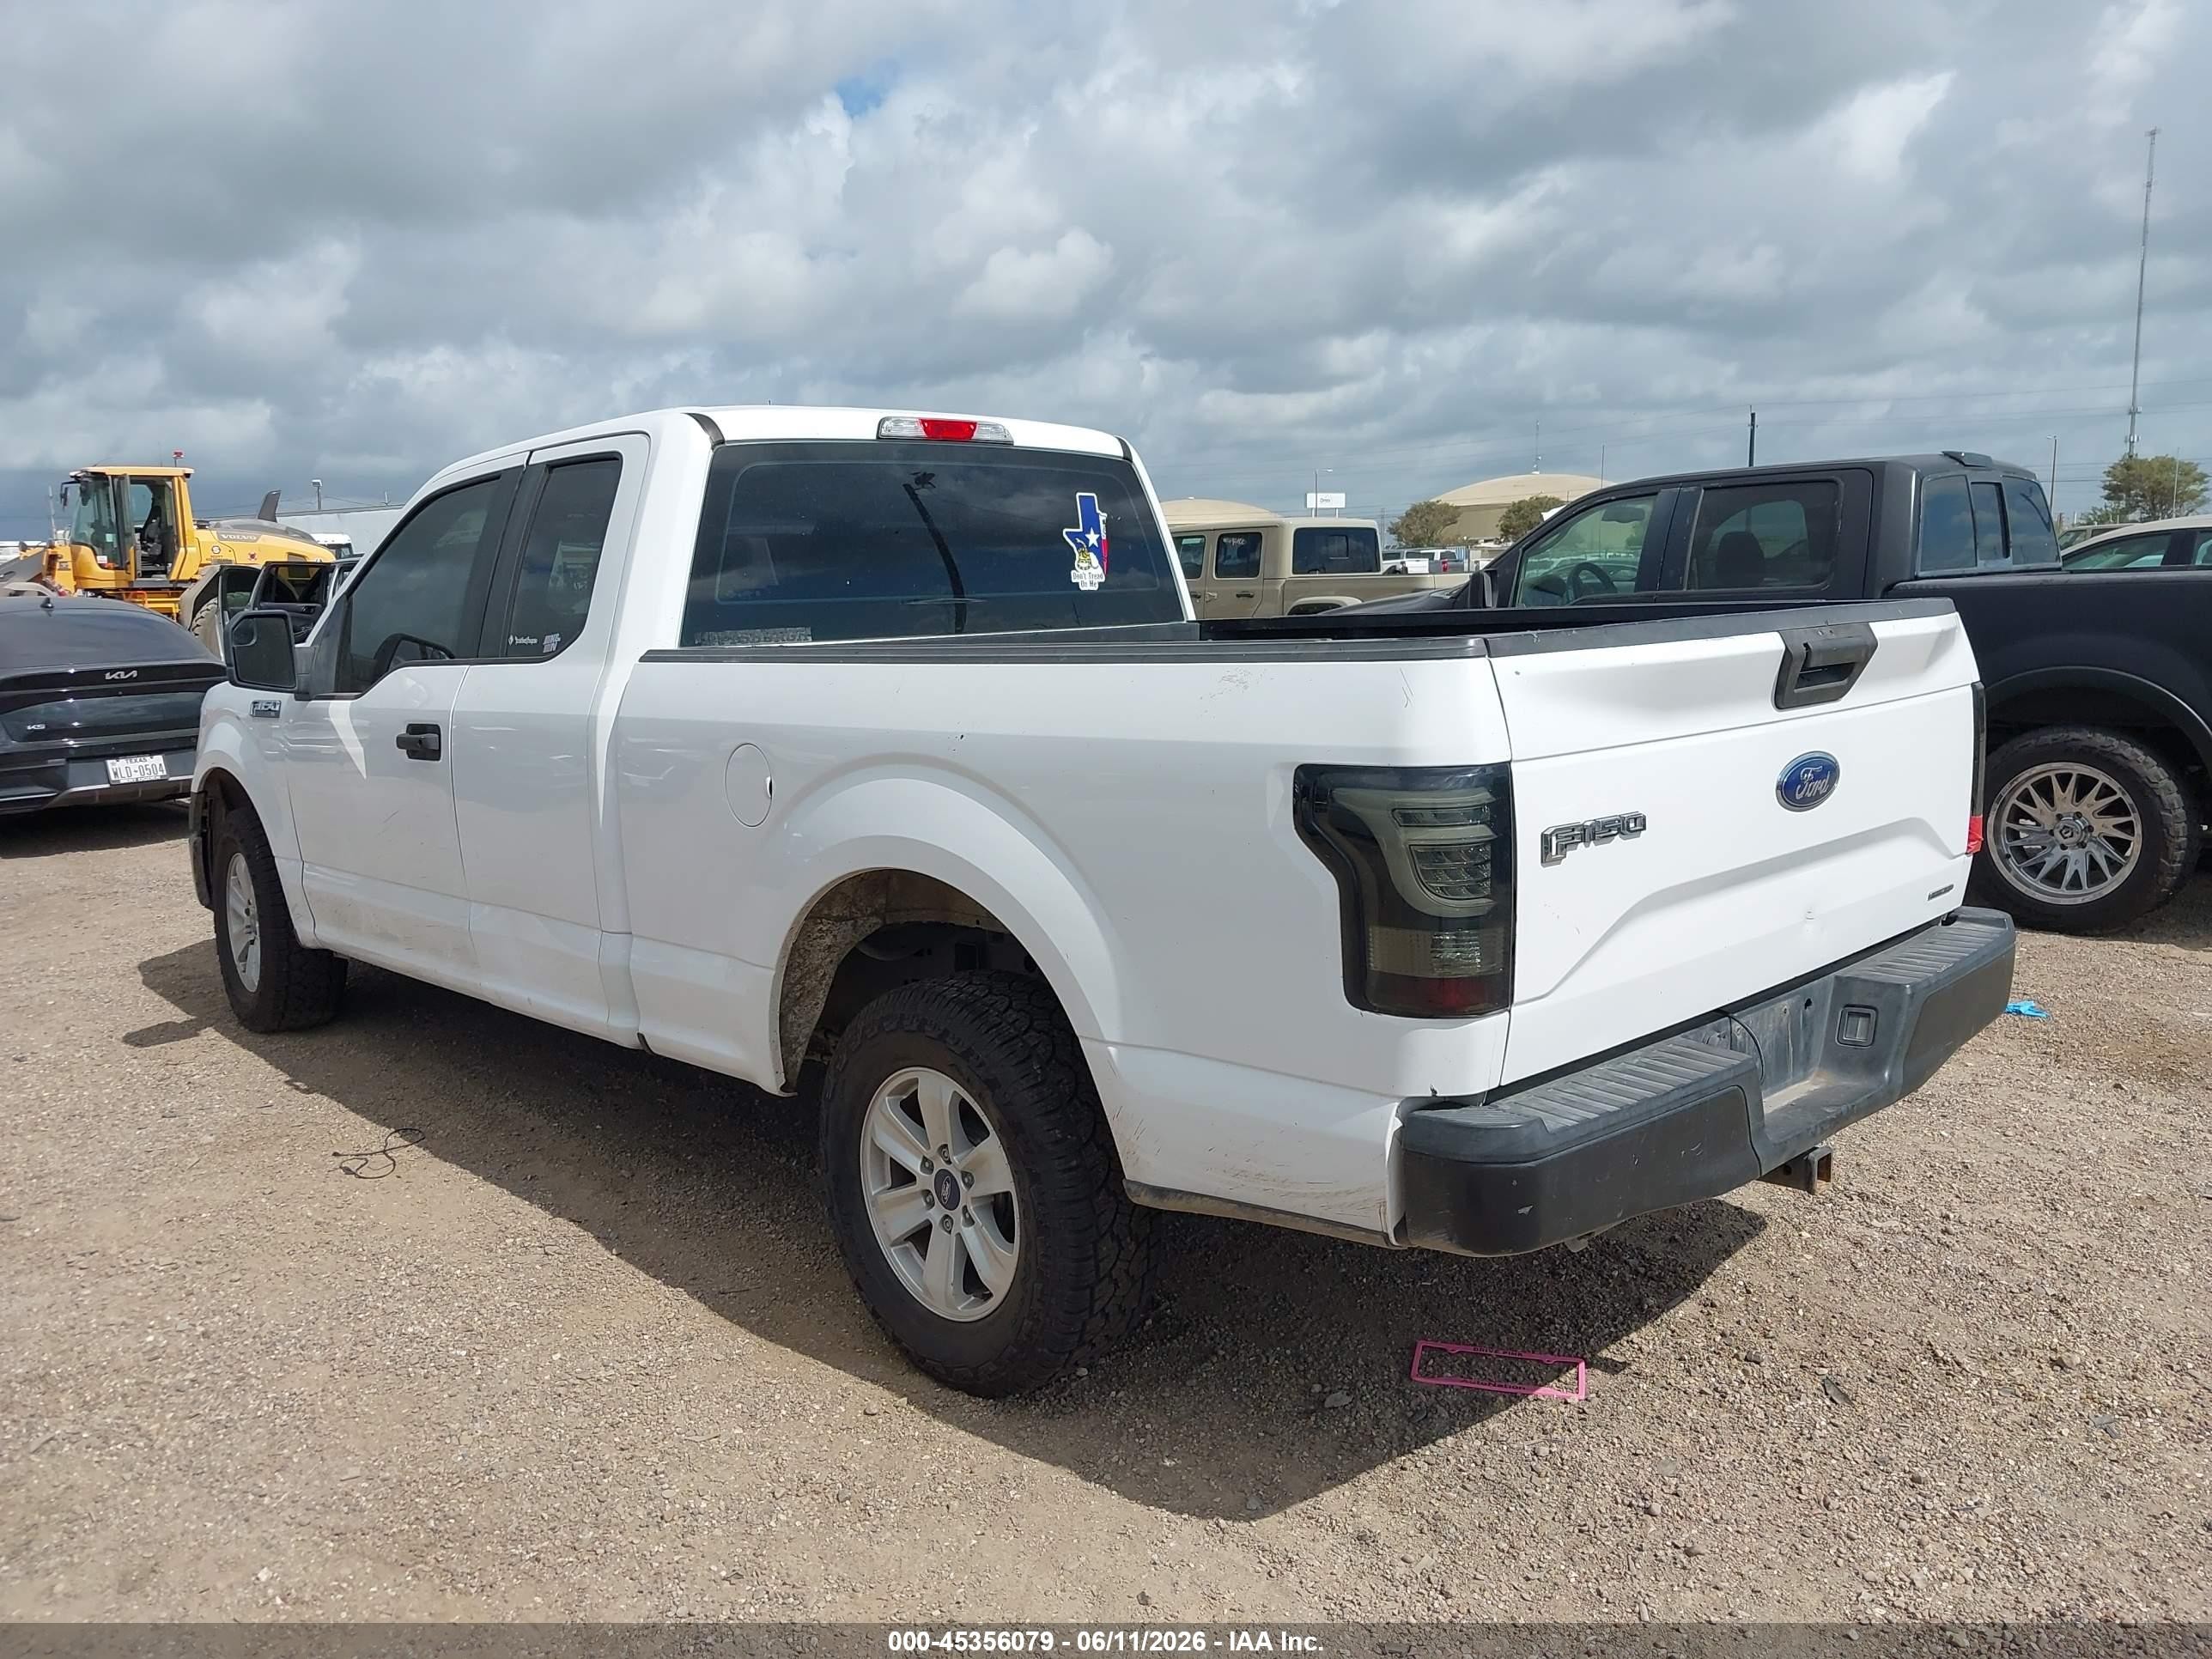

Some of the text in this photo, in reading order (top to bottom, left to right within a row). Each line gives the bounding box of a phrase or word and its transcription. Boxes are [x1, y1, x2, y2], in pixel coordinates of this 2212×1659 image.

[1089, 580, 1097, 588] Me
[105, 670, 137, 680] KIA
[112, 763, 164, 779] WLD-0504
[1795, 765, 1831, 799] Ford
